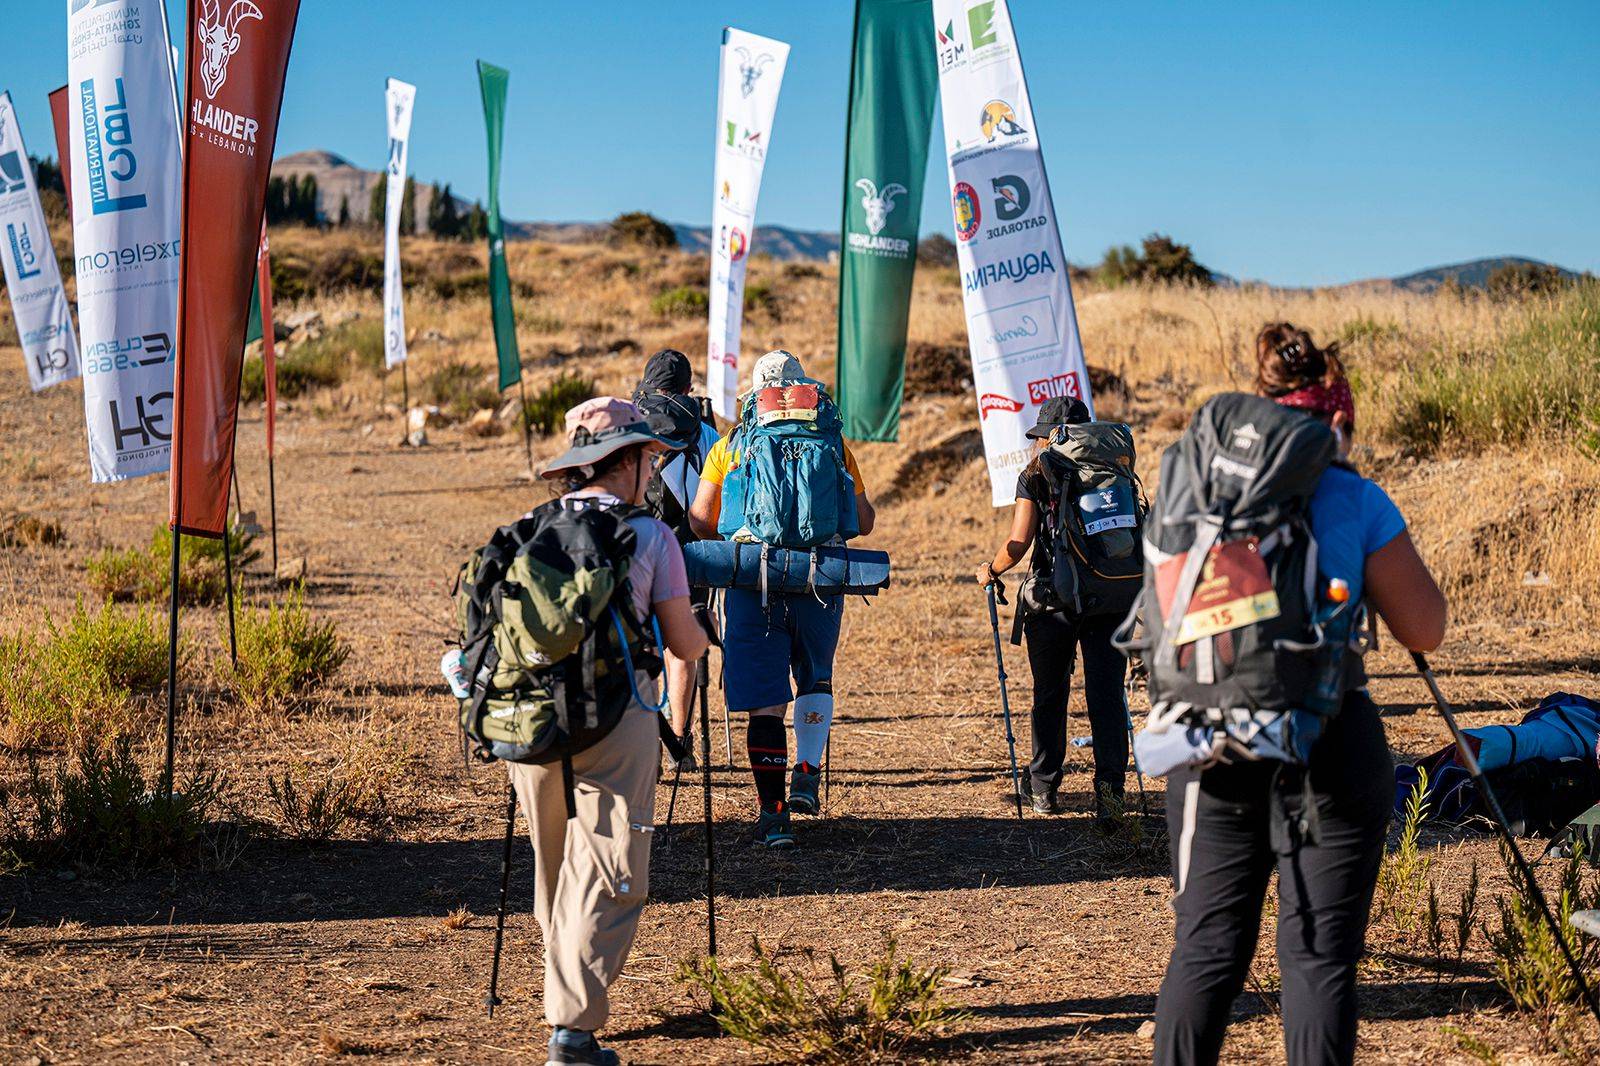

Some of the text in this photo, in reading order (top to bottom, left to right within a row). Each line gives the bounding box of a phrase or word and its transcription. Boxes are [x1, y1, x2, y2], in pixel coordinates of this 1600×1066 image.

[192, 98, 259, 143] HLANDER
[208, 132, 255, 156] LEBANON
[1211, 608, 1233, 626] 15
